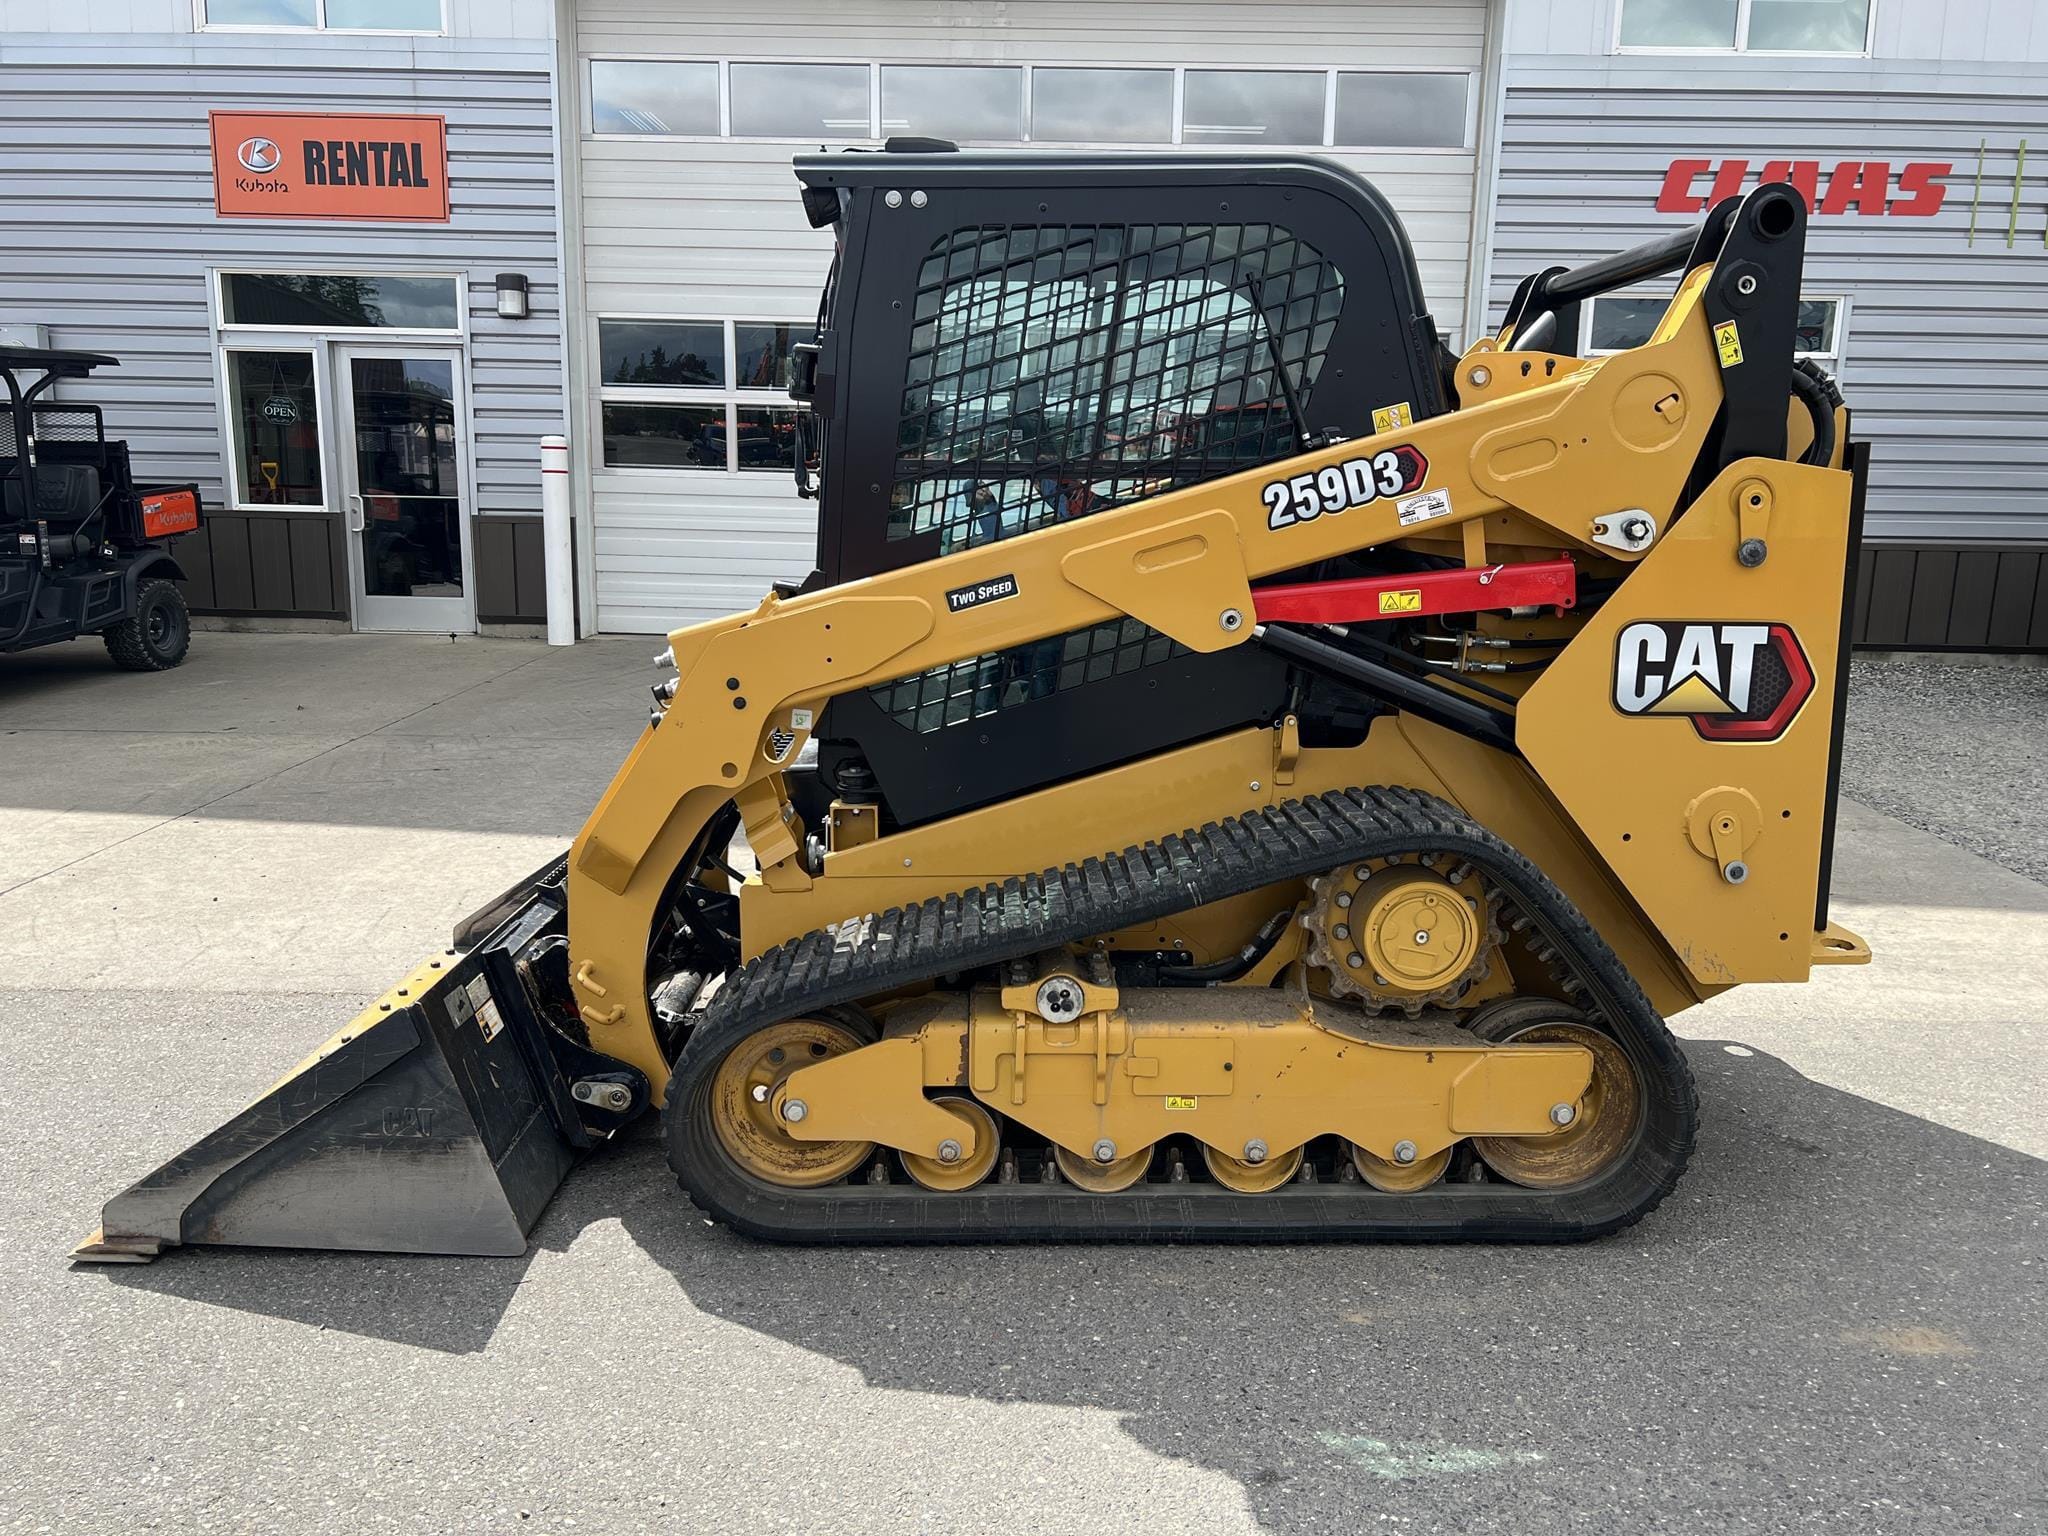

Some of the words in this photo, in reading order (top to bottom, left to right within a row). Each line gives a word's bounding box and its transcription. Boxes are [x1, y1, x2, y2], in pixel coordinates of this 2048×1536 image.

[303, 140, 429, 188] RENTAL
[235, 177, 289, 193] Kubota
[264, 405, 296, 417] OPEN
[1263, 451, 1404, 528] 259D3
[160, 510, 194, 526] Kubota
[1616, 623, 1769, 713] CAT
[383, 1106, 433, 1137] CAT
